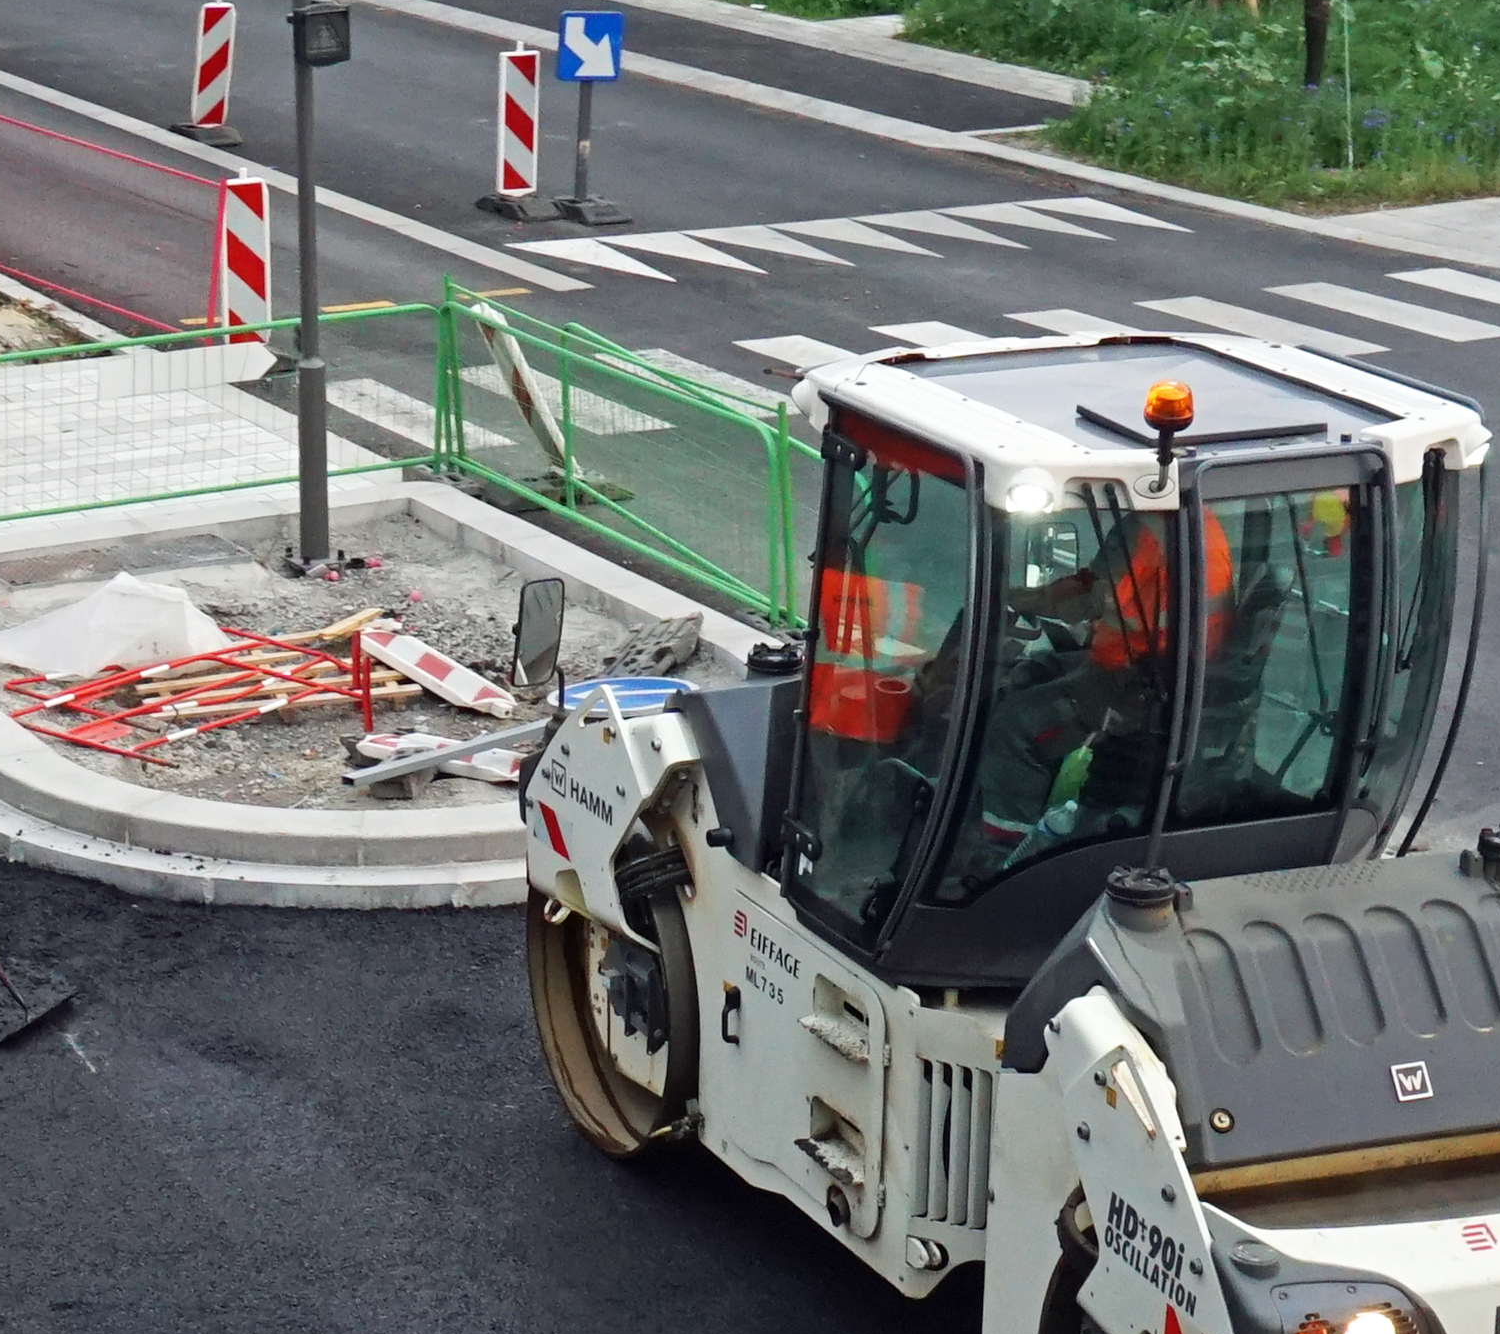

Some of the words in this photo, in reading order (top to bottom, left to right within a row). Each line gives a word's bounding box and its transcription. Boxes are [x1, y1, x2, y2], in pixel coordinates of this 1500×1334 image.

[571, 777, 613, 826] HAMM
[750, 927, 801, 979] EIFFAGE
[745, 964, 784, 1005] ML735
[1104, 1224, 1197, 1318] OSCILLATION
